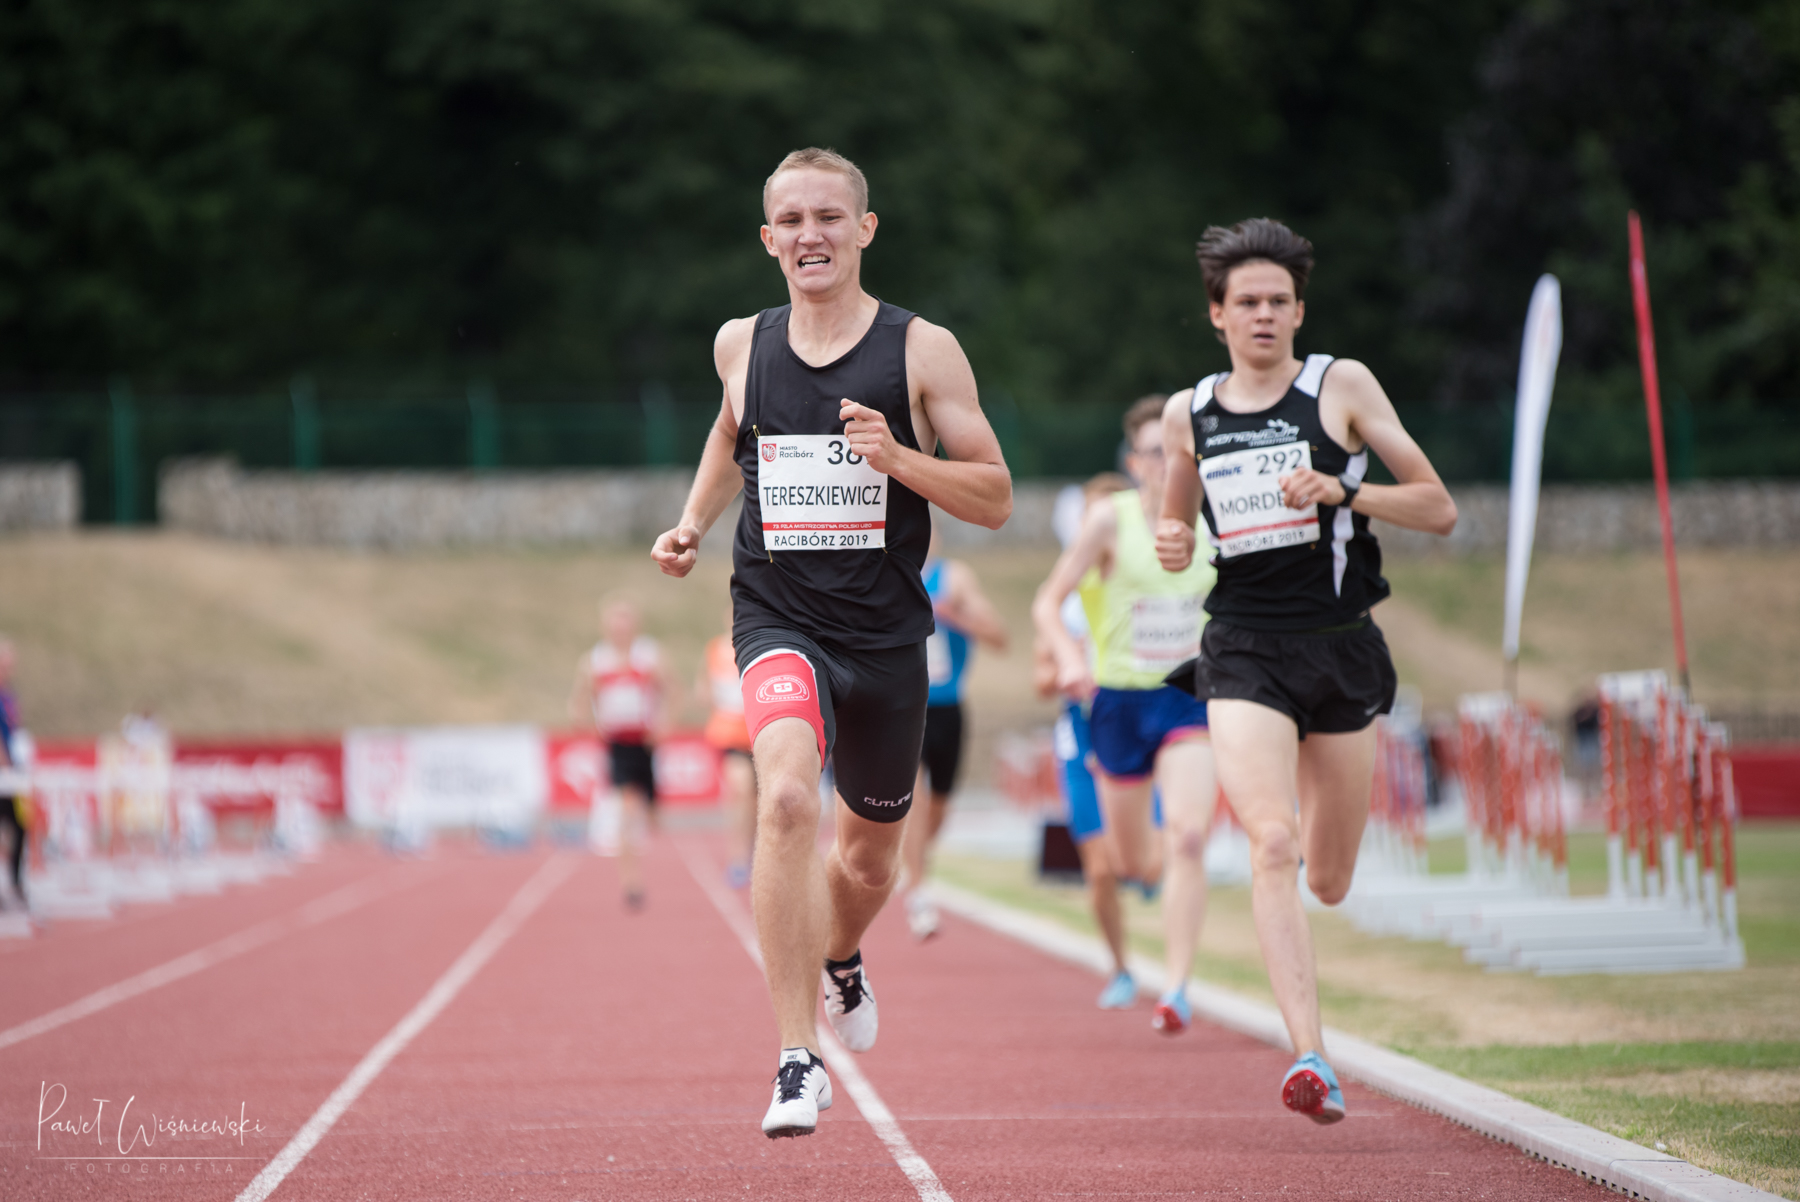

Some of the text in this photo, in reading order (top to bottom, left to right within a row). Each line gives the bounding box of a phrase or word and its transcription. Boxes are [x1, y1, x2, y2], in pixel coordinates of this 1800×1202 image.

[779, 450, 814, 458] Racibórz
[827, 440, 870, 465] 36
[1256, 449, 1302, 475] 292
[763, 485, 881, 506] TERESZKIEWICZ
[774, 532, 869, 546] RACIBÓRZ 2019
